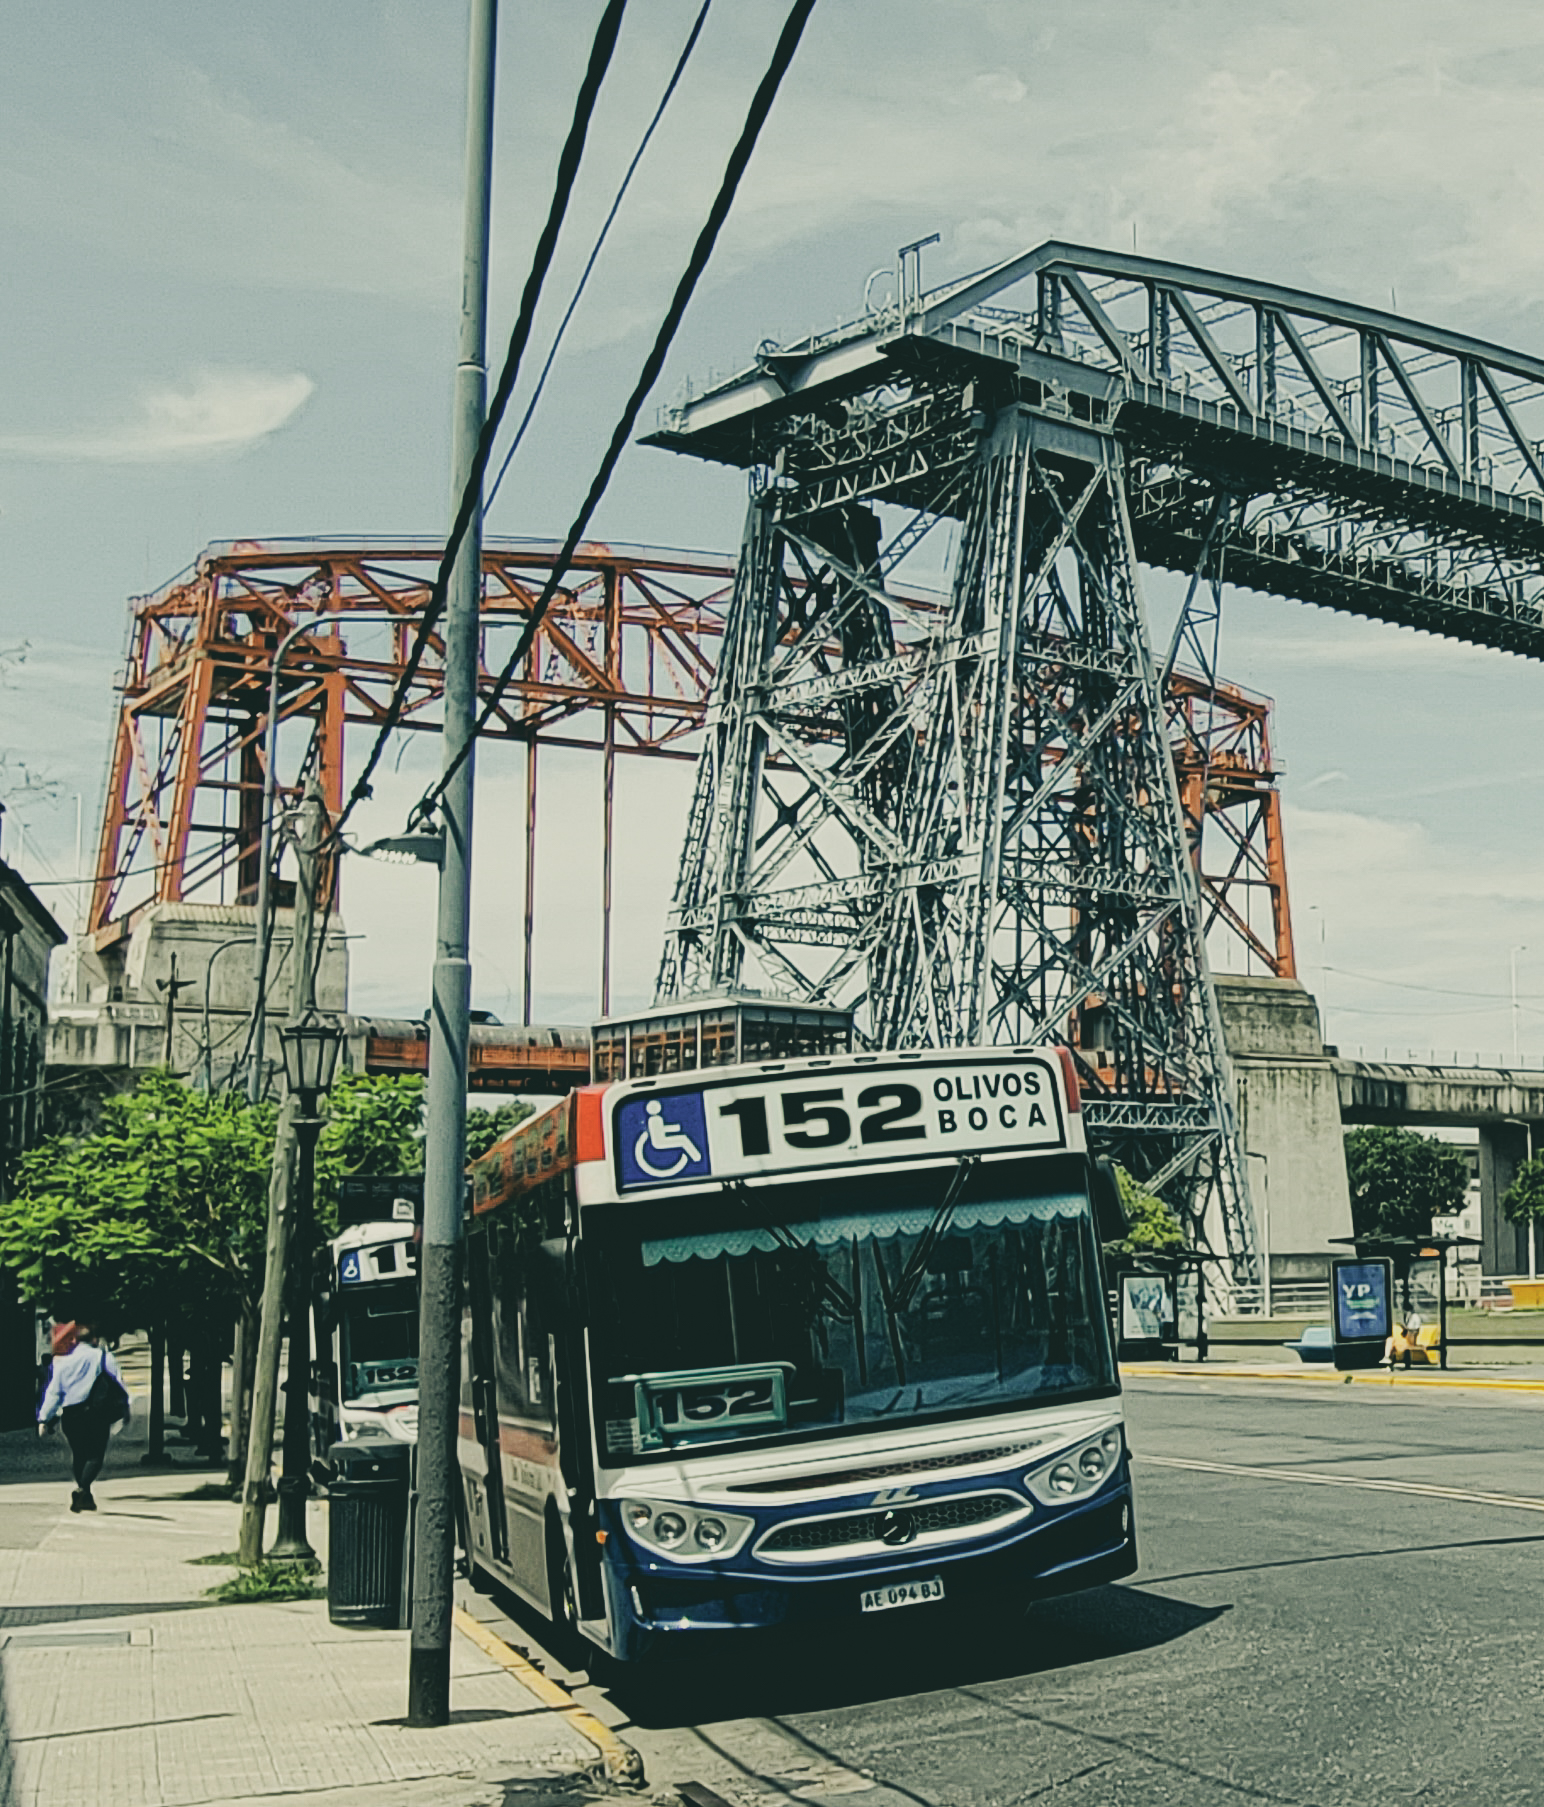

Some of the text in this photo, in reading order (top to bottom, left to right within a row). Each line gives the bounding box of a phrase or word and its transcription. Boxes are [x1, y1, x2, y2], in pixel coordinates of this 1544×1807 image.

[933, 1071, 1041, 1102] OLIVOS
[719, 1083, 927, 1157] 152
[938, 1103, 1047, 1134] BOCA
[653, 1378, 773, 1424] 152
[865, 1581, 941, 1608] AE 094 BJ
